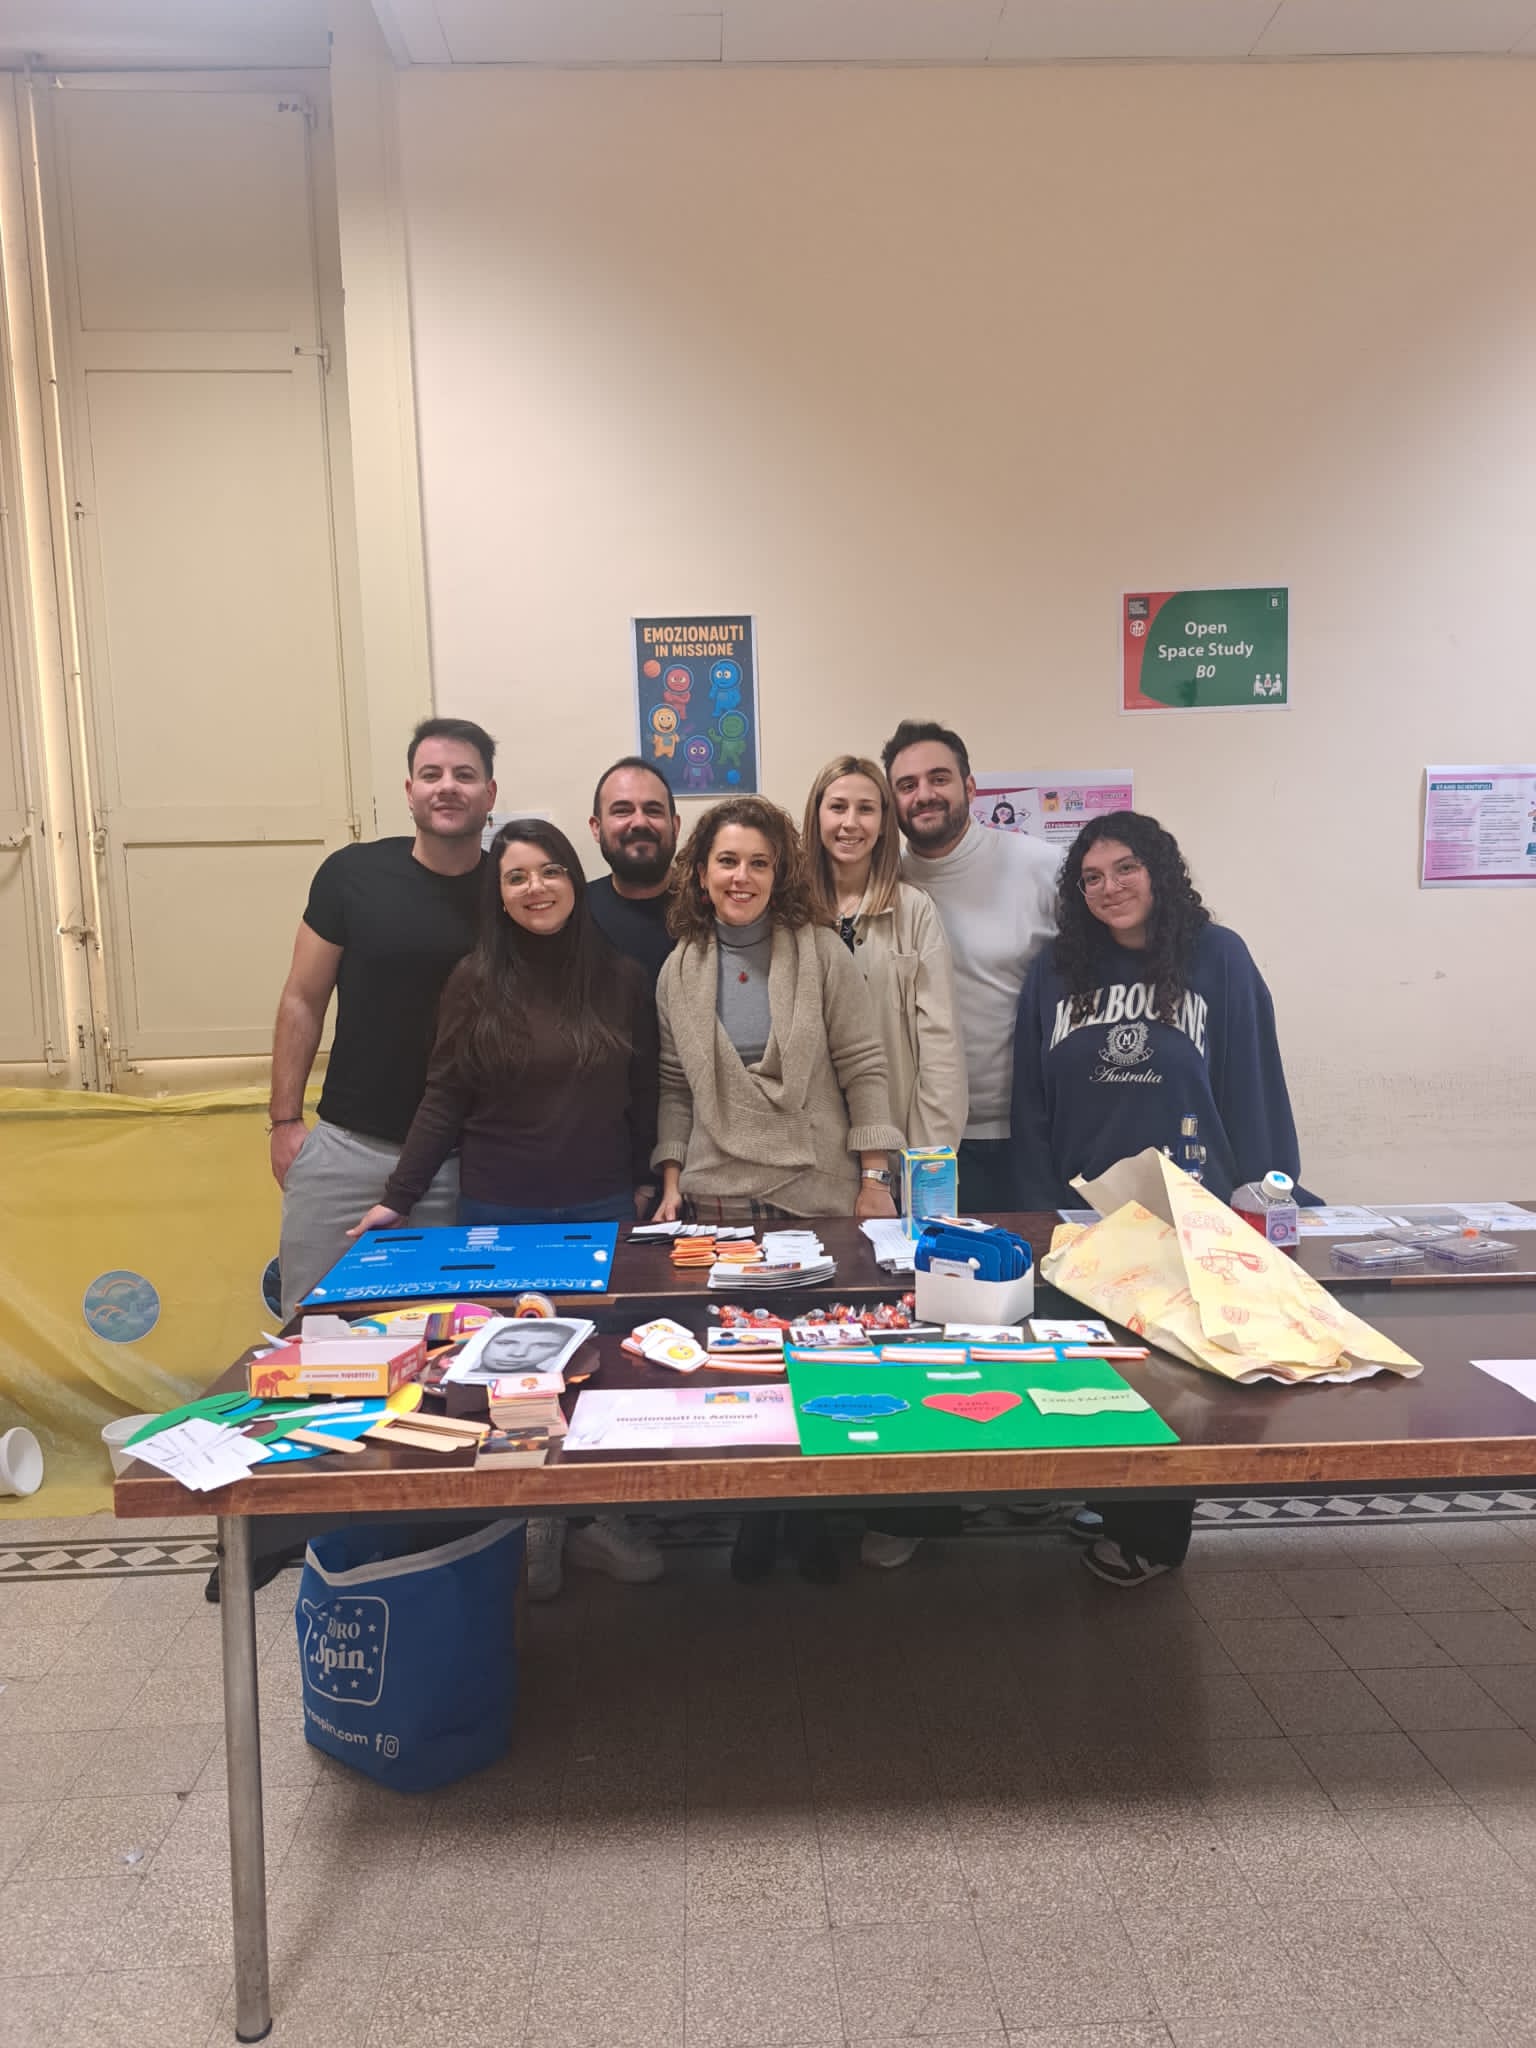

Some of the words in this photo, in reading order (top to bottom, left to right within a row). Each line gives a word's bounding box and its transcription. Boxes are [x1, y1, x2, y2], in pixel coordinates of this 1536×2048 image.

[643, 624, 744, 644] EMOZIONAUTI
[1184, 621, 1228, 638] Open
[655, 644, 669, 657] IN
[672, 642, 734, 657] MISSIONE
[1158, 644, 1205, 661] Space
[1208, 641, 1254, 658] Study
[1089, 1066, 1164, 1084] Australia
[315, 1634, 366, 1675] Spin
